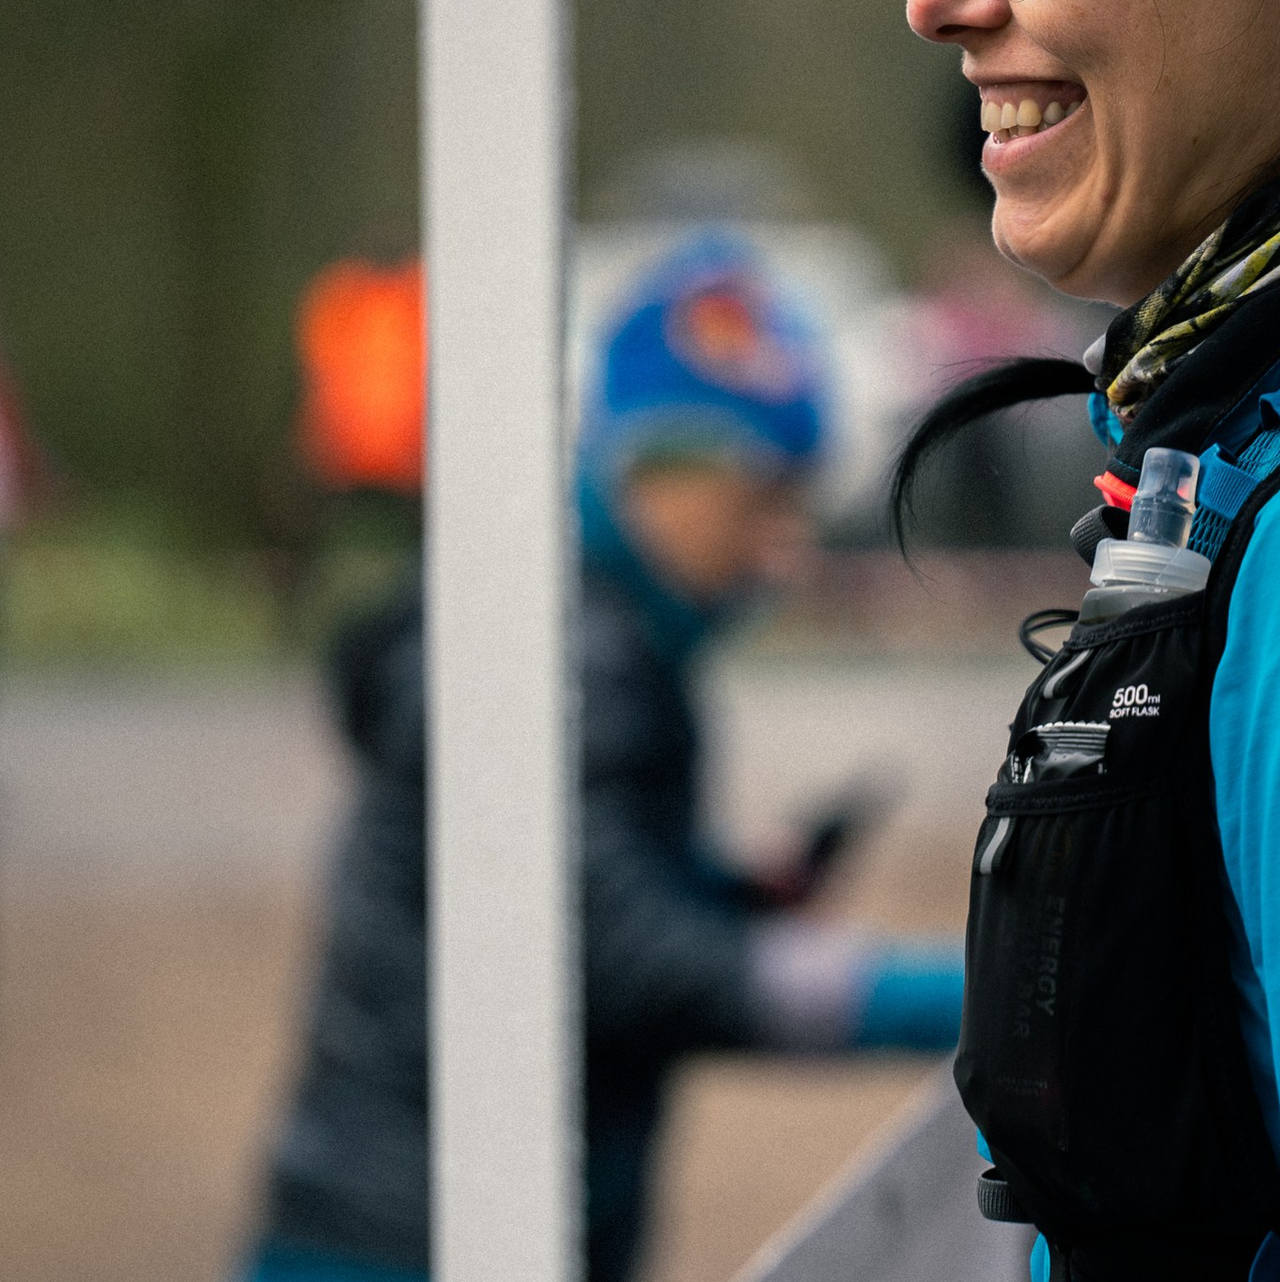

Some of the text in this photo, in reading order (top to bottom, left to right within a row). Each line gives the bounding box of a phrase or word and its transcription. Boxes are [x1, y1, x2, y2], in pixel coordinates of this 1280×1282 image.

[1112, 683, 1161, 708] 500ml
[1109, 706, 1160, 719] SOFT FLASK
[1037, 895, 1067, 1016] ENERGY
